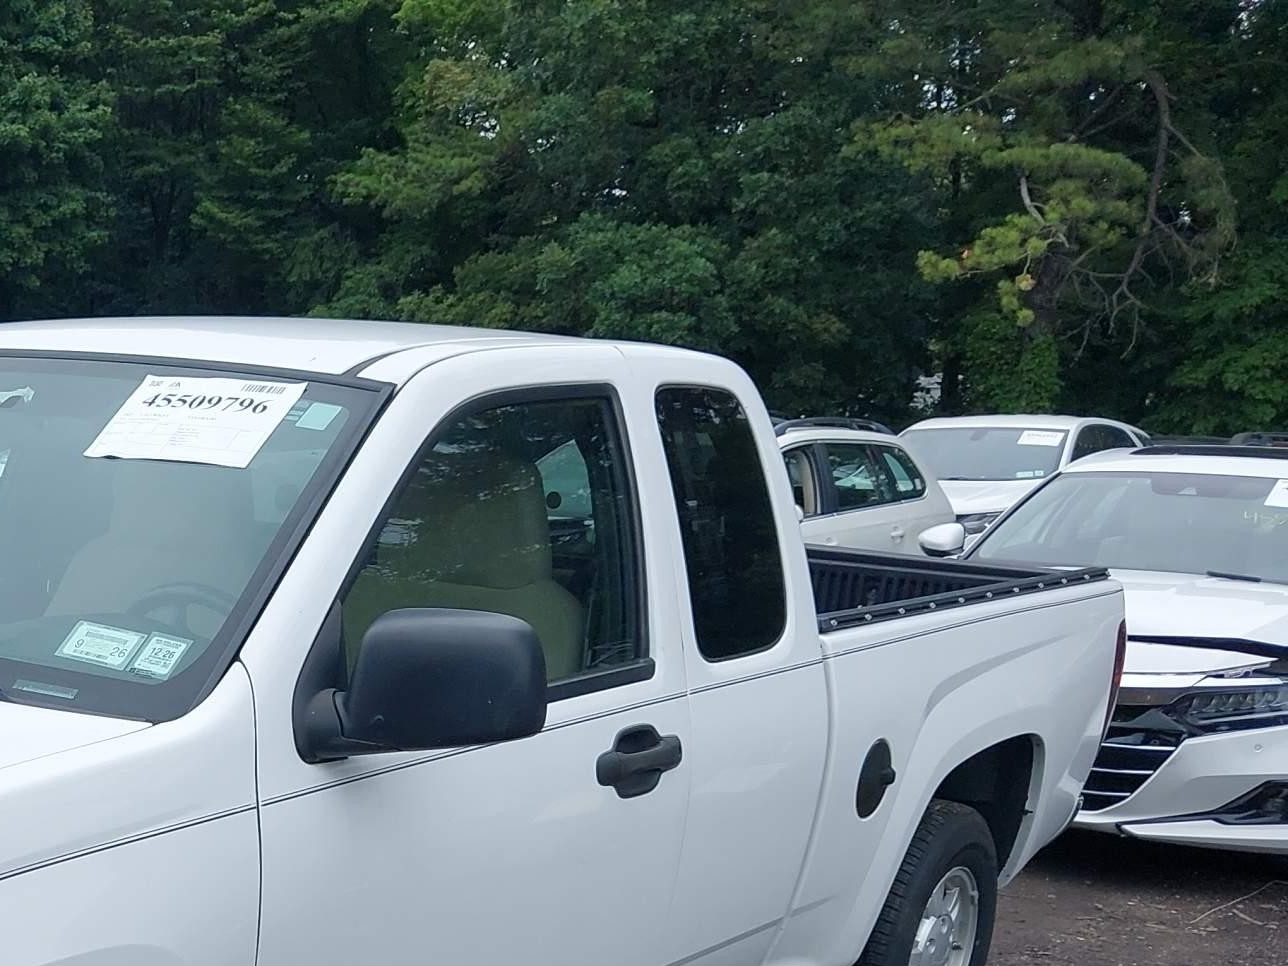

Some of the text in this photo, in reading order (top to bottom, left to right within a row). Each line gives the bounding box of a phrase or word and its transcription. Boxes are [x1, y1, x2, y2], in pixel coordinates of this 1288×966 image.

[142, 392, 273, 415] 45509796
[74, 638, 85, 649] 9
[109, 646, 129, 658] 26
